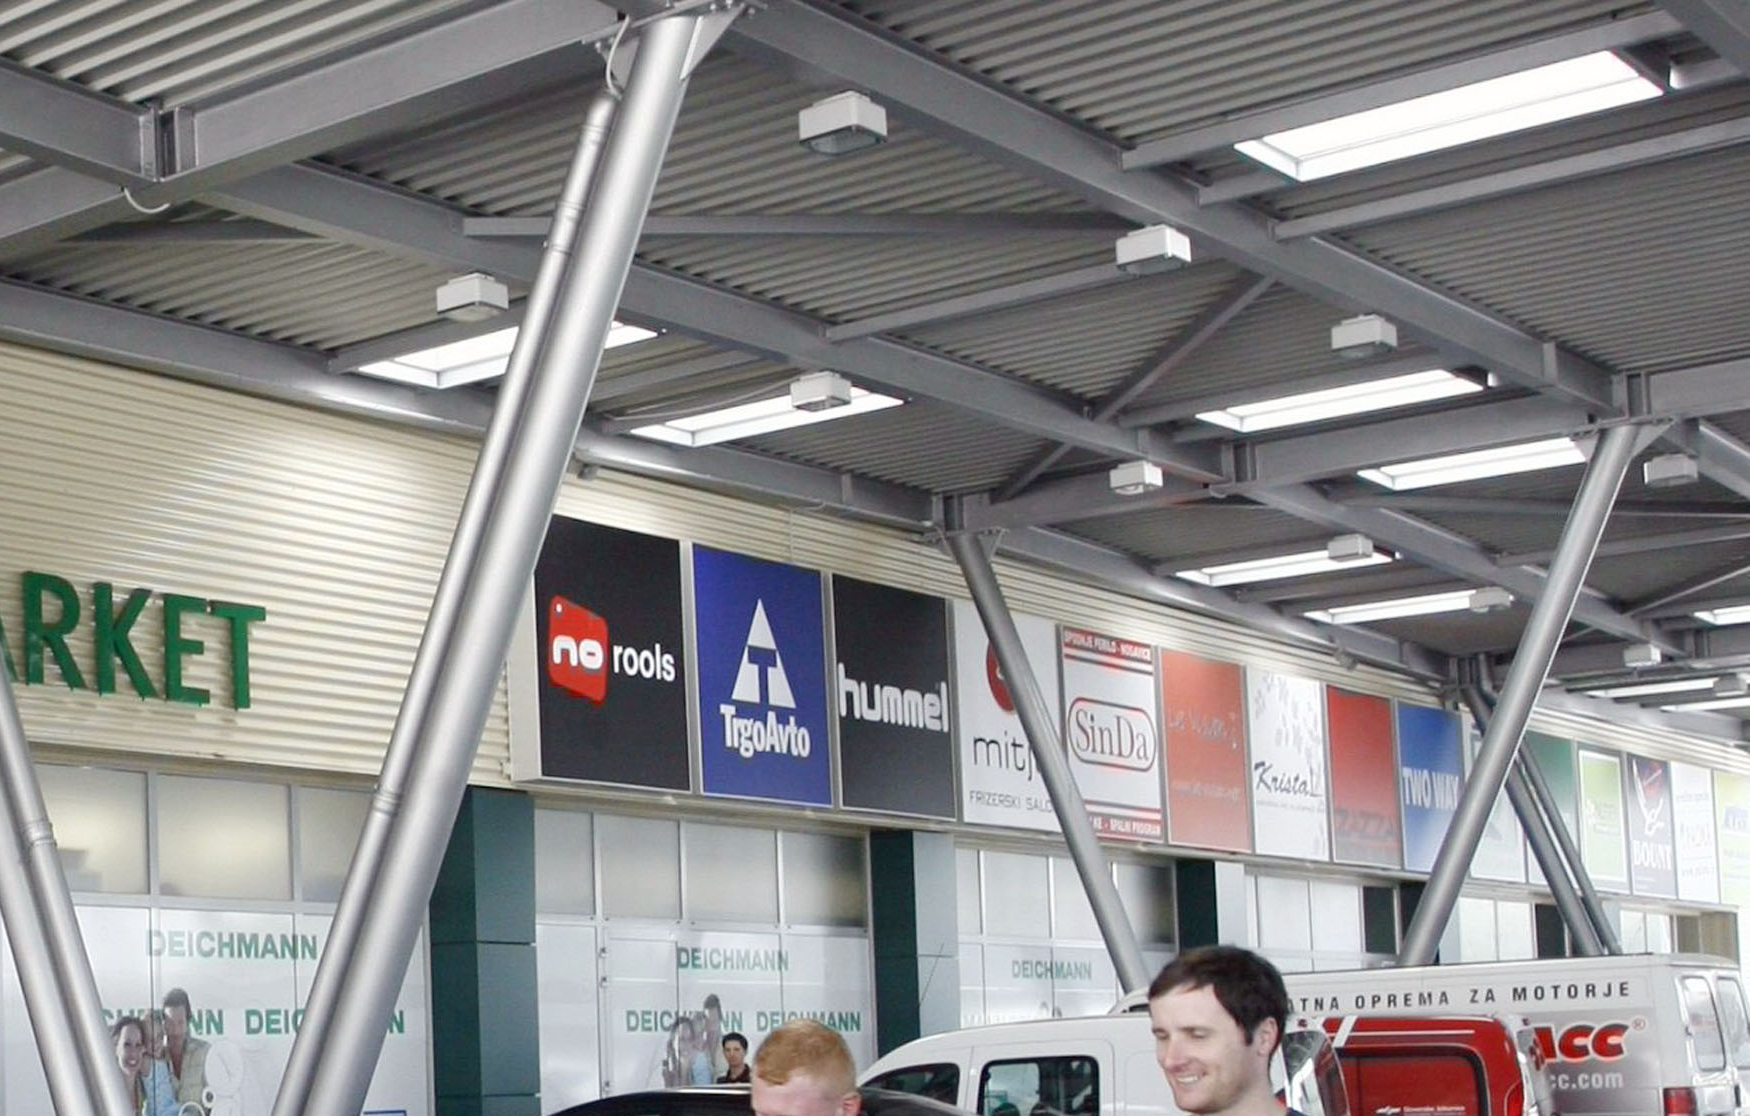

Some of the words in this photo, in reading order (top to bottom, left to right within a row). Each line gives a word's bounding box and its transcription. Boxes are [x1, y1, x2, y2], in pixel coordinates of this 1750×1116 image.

[613, 643, 676, 682] rools
[838, 662, 949, 733] hummel
[720, 703, 811, 758] TrgoAvto
[1075, 708, 1149, 762] SinDa
[973, 731, 1040, 781] mitj
[969, 790, 1021, 809] FRIZERSKI
[1026, 796, 1053, 813] SALO
[1402, 767, 1431, 809] TWO
[146, 930, 317, 960] DEICHMANN
[677, 947, 789, 971] DEICHMANN
[1012, 960, 1092, 980] DEICHMANN
[1355, 991, 1450, 1010] OPREMA
[1470, 988, 1496, 1003] ZA
[1512, 981, 1629, 1001] MOTORJE
